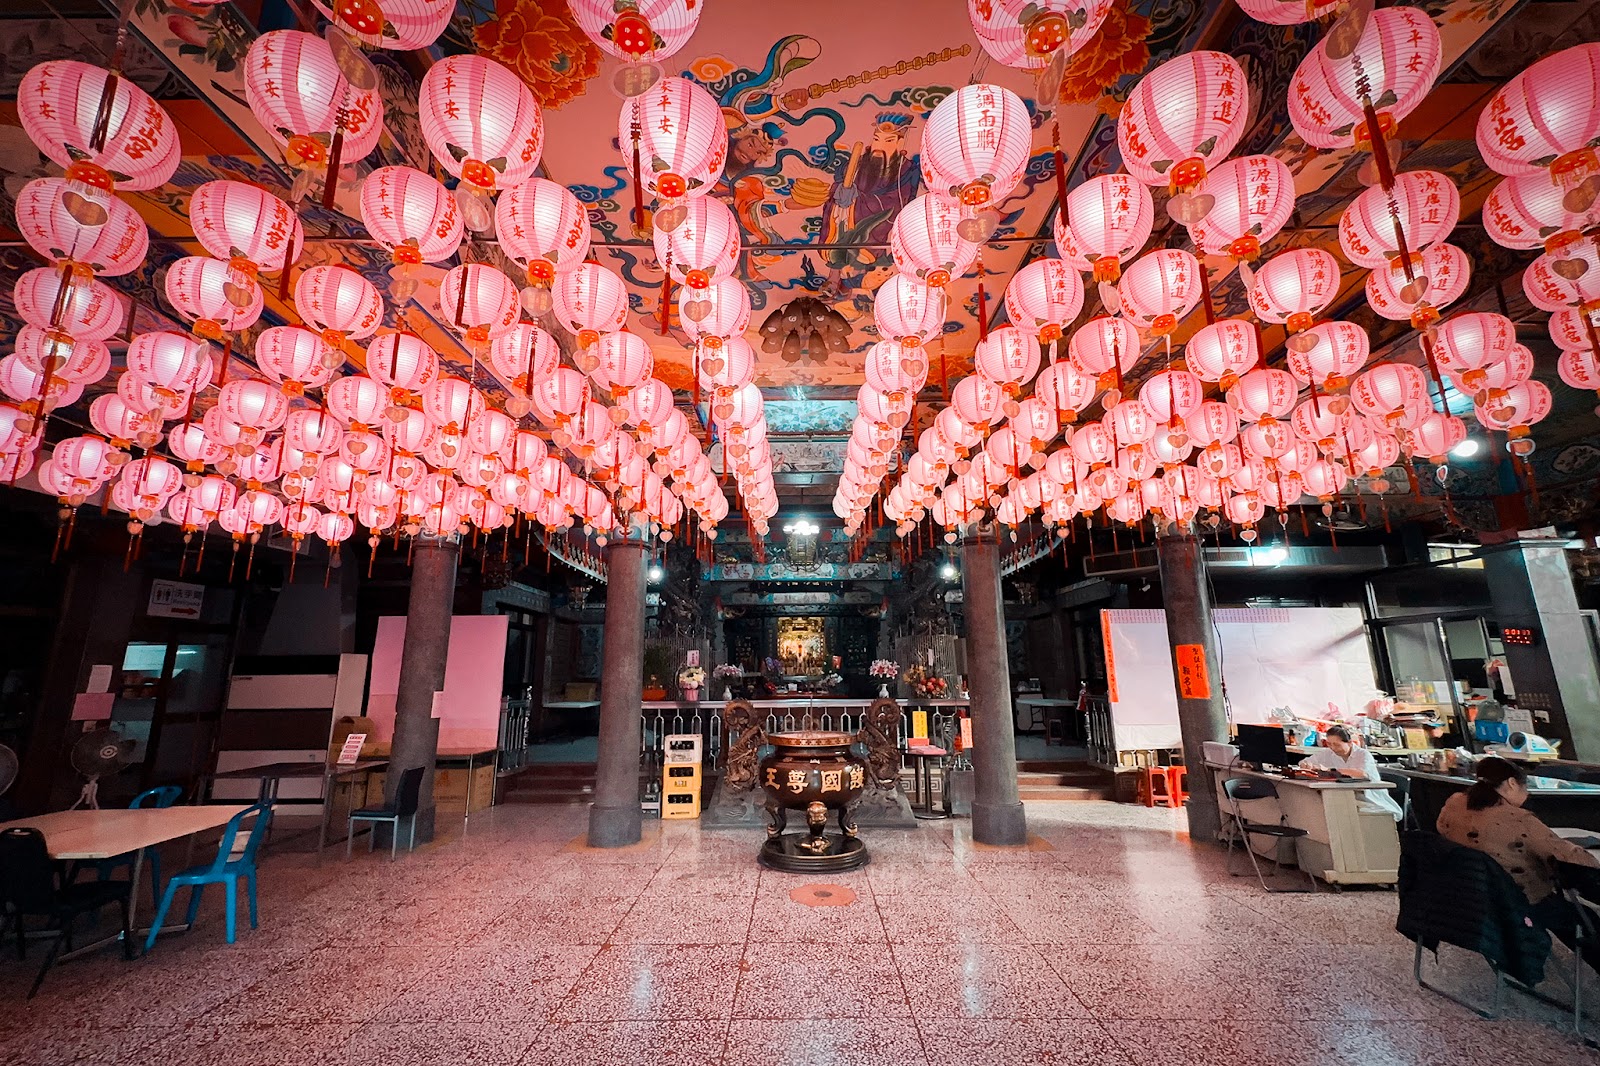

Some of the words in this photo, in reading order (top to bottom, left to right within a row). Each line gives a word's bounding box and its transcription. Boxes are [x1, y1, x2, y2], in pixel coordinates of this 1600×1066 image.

[1248, 158, 1273, 216] 財源廣進
[1414, 172, 1442, 224] 財源廣進
[1306, 251, 1328, 296] 財源廣進
[1224, 323, 1243, 366] 財源廣進
[1338, 324, 1355, 366] 財源廣進
